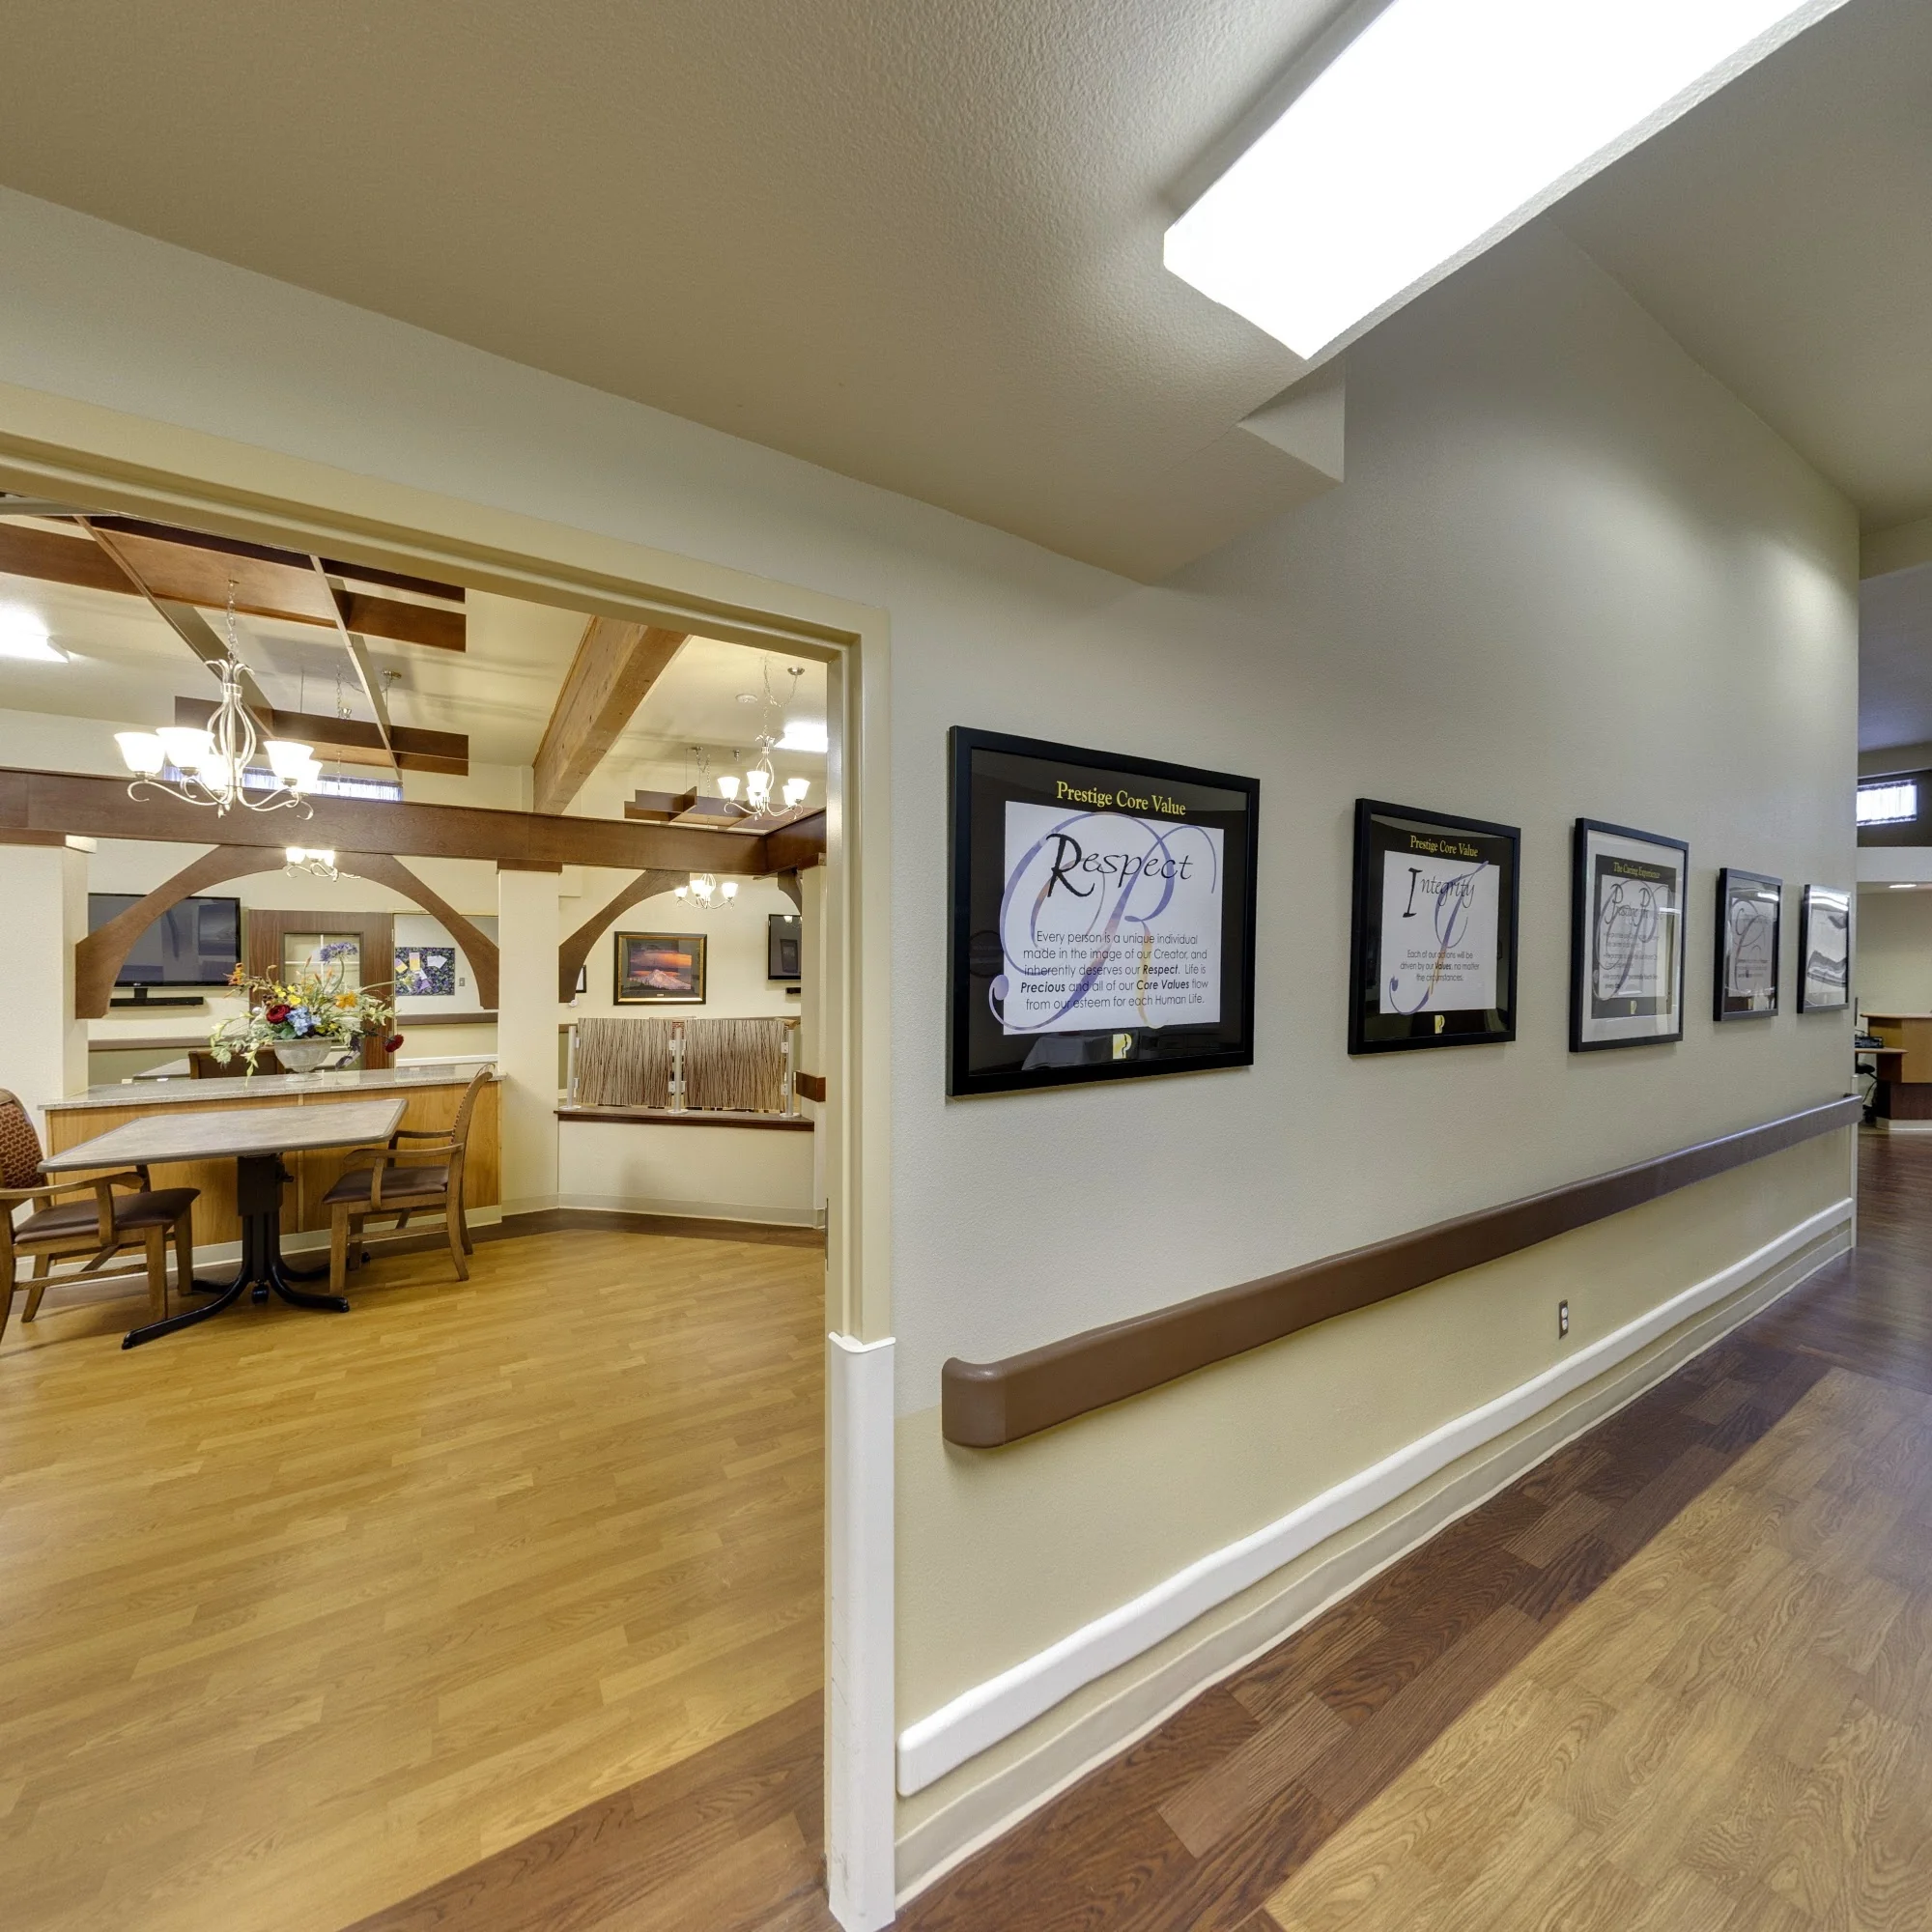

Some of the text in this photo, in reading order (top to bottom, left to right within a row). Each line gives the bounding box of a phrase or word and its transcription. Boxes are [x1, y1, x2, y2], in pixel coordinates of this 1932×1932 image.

[1056, 781, 1186, 815] Prestige Core Value
[1410, 835, 1478, 856] Prestige Core Value
[1045, 833, 1194, 898] Respect
[1613, 862, 1623, 873] The
[1403, 867, 1475, 918] Integrity
[1037, 930, 1198, 946] Every person is a unique individual
[1023, 947, 1208, 962] made in the image of our Creator, and
[1407, 949, 1421, 958] Each
[1422, 950, 1428, 958] of
[1024, 964, 1206, 978] inherently deserves our Respect. Life is
[1400, 962, 1417, 970] driven
[1418, 962, 1425, 972] by
[1020, 979, 1209, 993] Precious and all of our Core Values flow
[1026, 993, 1205, 1010] from our esteem for each Human Life.
